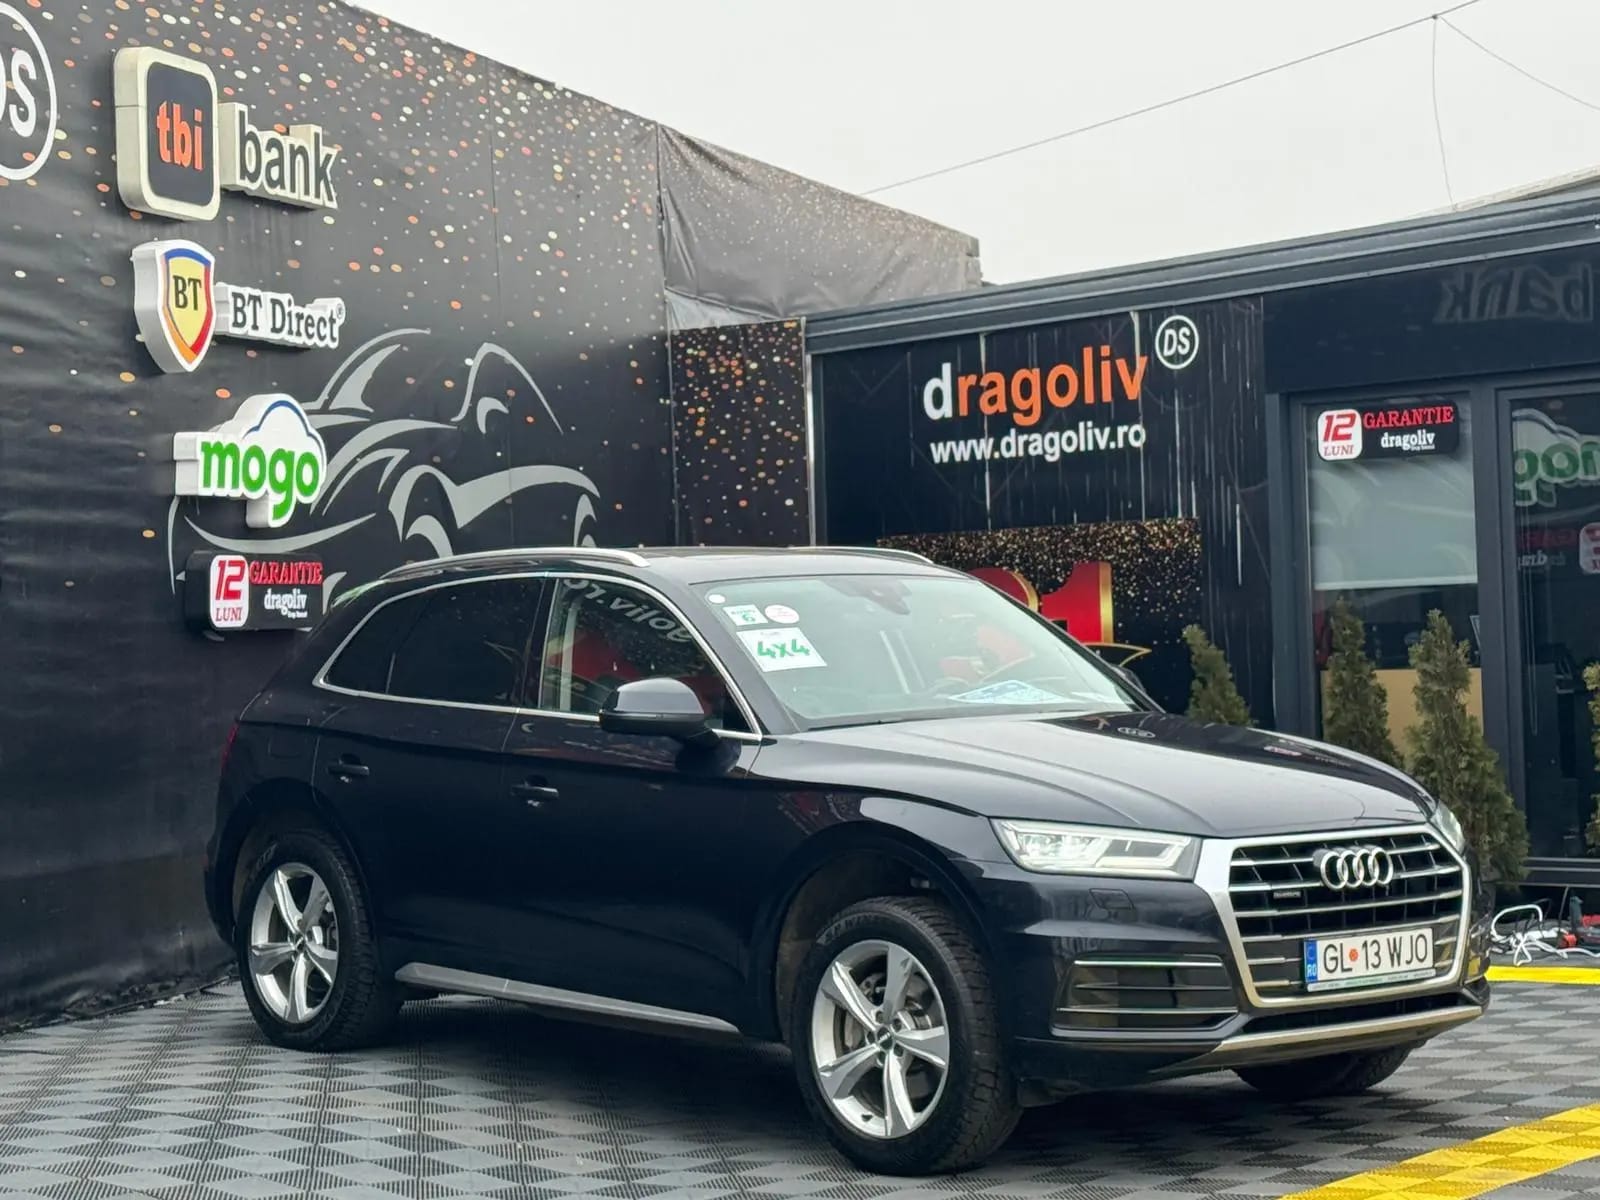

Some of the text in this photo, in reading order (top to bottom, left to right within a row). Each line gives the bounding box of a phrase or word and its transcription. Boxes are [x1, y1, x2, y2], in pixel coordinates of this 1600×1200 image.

[0, 50, 36, 137] S
[157, 101, 336, 203] tbi bank
[173, 275, 202, 311] BT
[232, 292, 262, 330] BT
[1163, 326, 1190, 357] DS
[923, 345, 1147, 426] dragoliv
[1323, 413, 1356, 442] 12
[1363, 406, 1454, 429] GARANTIE
[930, 421, 1146, 463] www.dragoliv.ro
[1324, 445, 1354, 456] LUNI
[1381, 429, 1435, 451] dragoliv
[201, 440, 320, 521] mogo
[215, 560, 245, 600] 12
[250, 560, 323, 585] GARANTIE
[215, 607, 242, 622] LUNI
[264, 588, 307, 615] dragoliv
[1323, 933, 1428, 974] GL 13 WJO
